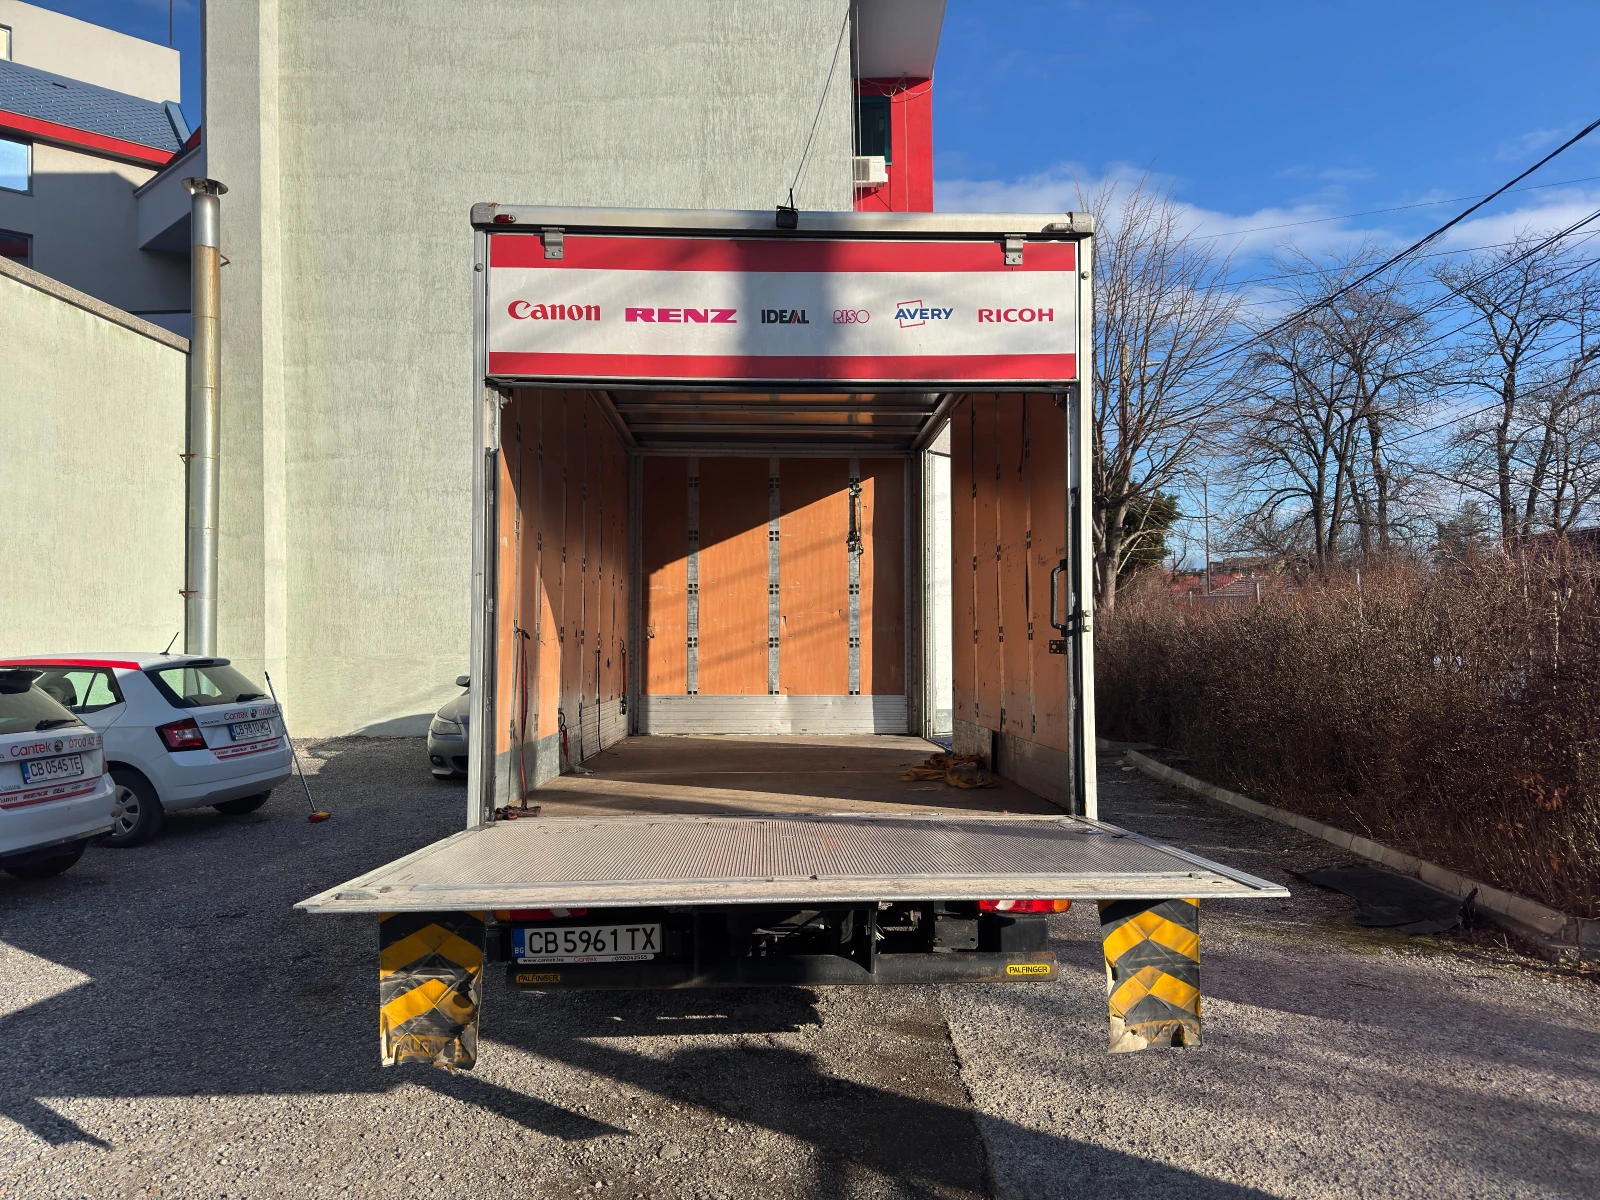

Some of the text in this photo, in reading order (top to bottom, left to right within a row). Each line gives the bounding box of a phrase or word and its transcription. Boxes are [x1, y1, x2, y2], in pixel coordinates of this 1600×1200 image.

[508, 300, 1054, 324] Canon RENZ IDEAL RISO AVERY RICOH
[10, 741, 51, 757] Cantek
[30, 760, 44, 777] CB
[68, 756, 81, 770] TE
[529, 931, 559, 954] CB
[563, 929, 618, 953] 5961
[626, 927, 656, 950] TX
[518, 974, 559, 982] PALFINGER
[1009, 966, 1048, 974] PALFINGER
